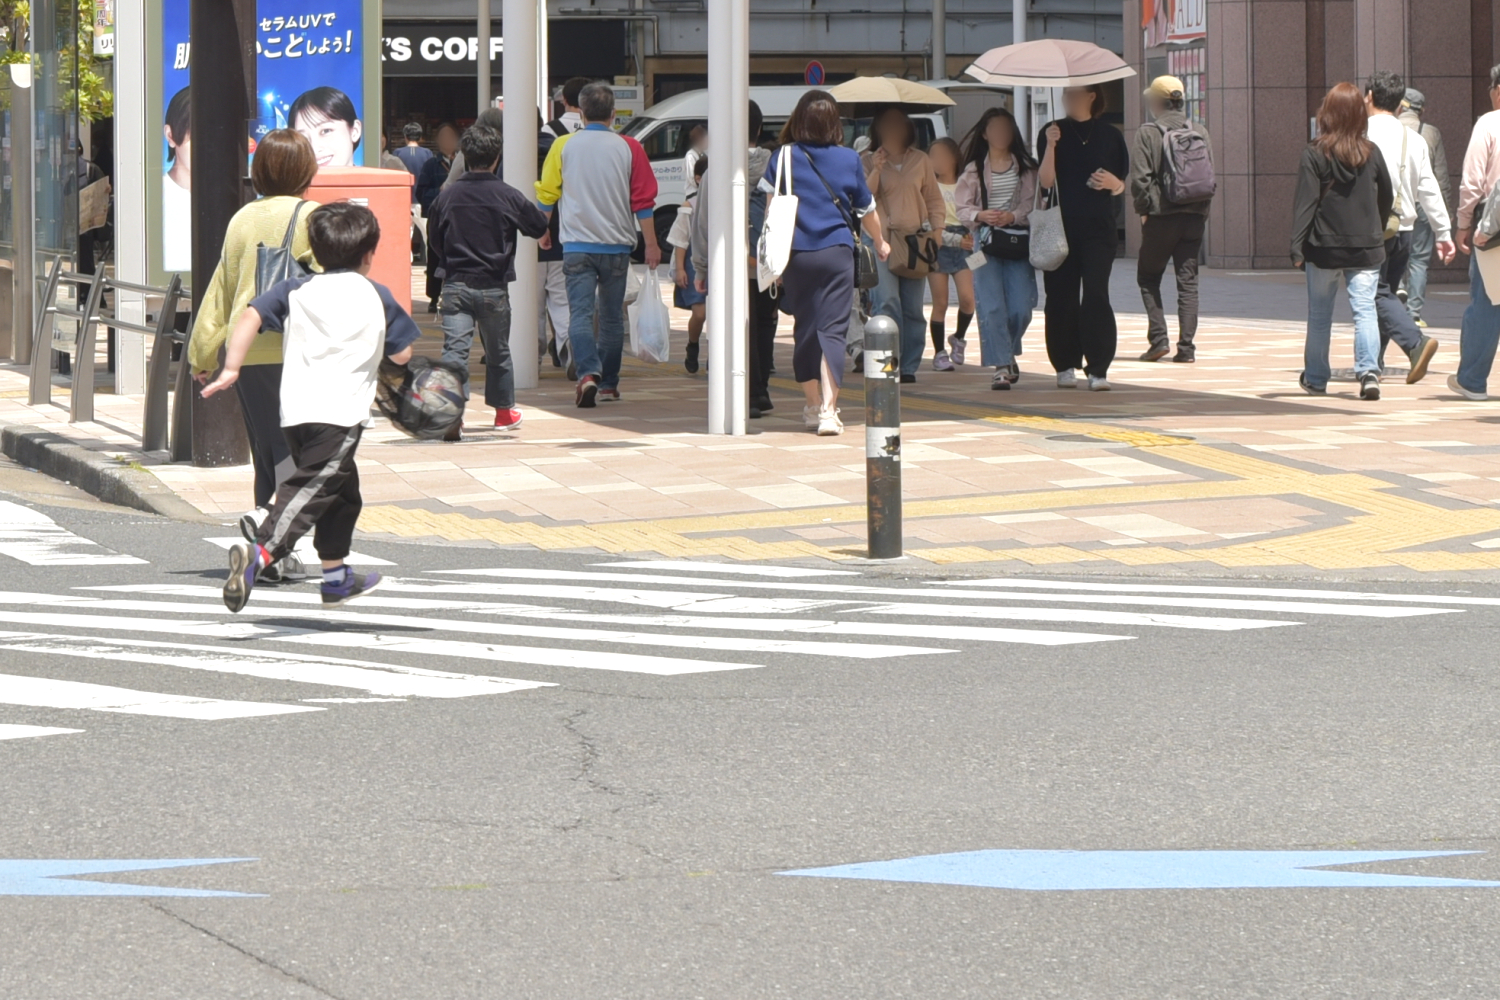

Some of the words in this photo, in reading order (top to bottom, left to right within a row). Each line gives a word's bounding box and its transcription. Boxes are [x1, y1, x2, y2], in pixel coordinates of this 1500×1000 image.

[259, 13, 336, 32] セラムUVで
[420, 36, 504, 61] COFF
